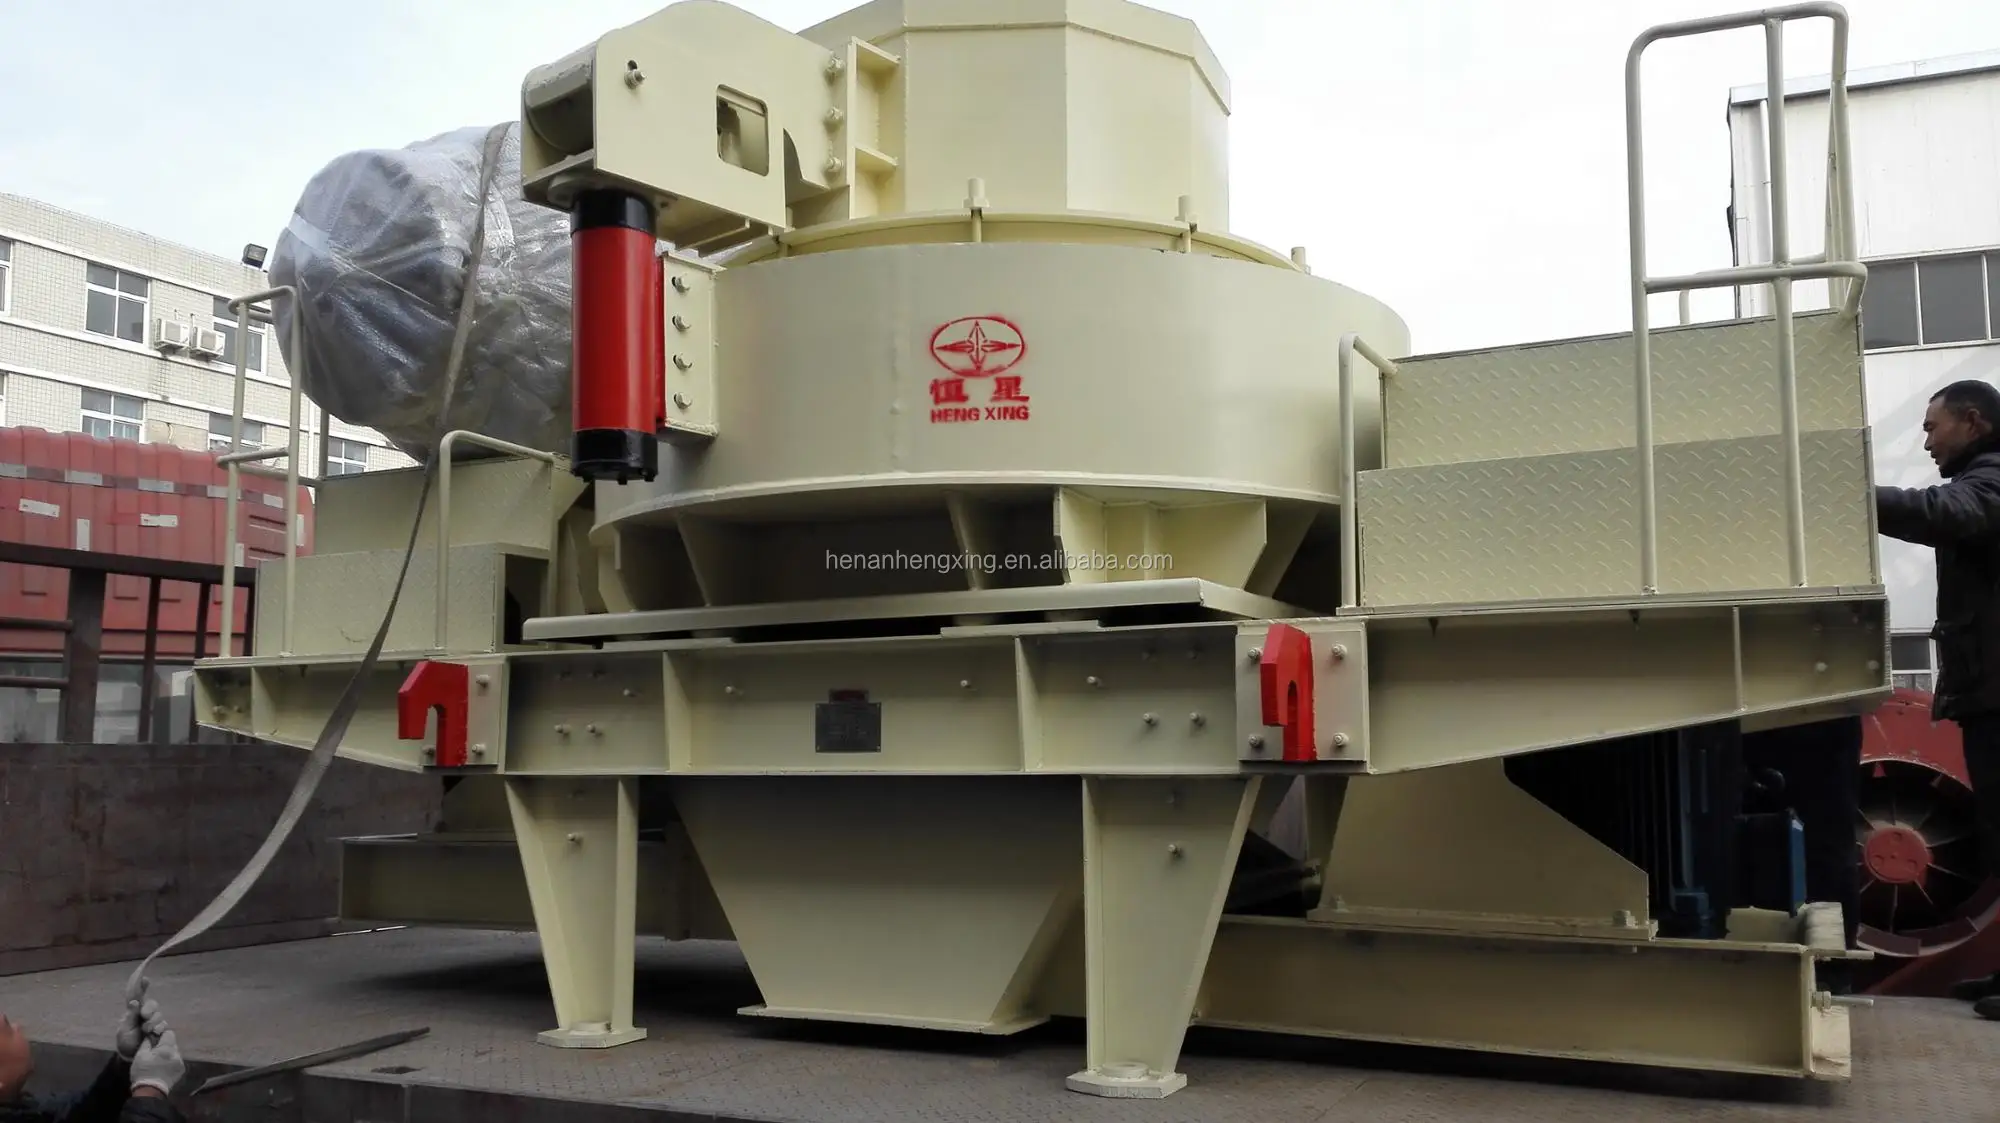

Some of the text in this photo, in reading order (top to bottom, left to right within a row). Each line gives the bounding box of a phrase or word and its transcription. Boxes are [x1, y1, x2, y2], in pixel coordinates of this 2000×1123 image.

[930, 376, 1030, 405] 恒星
[930, 406, 1029, 423] HENG XING
